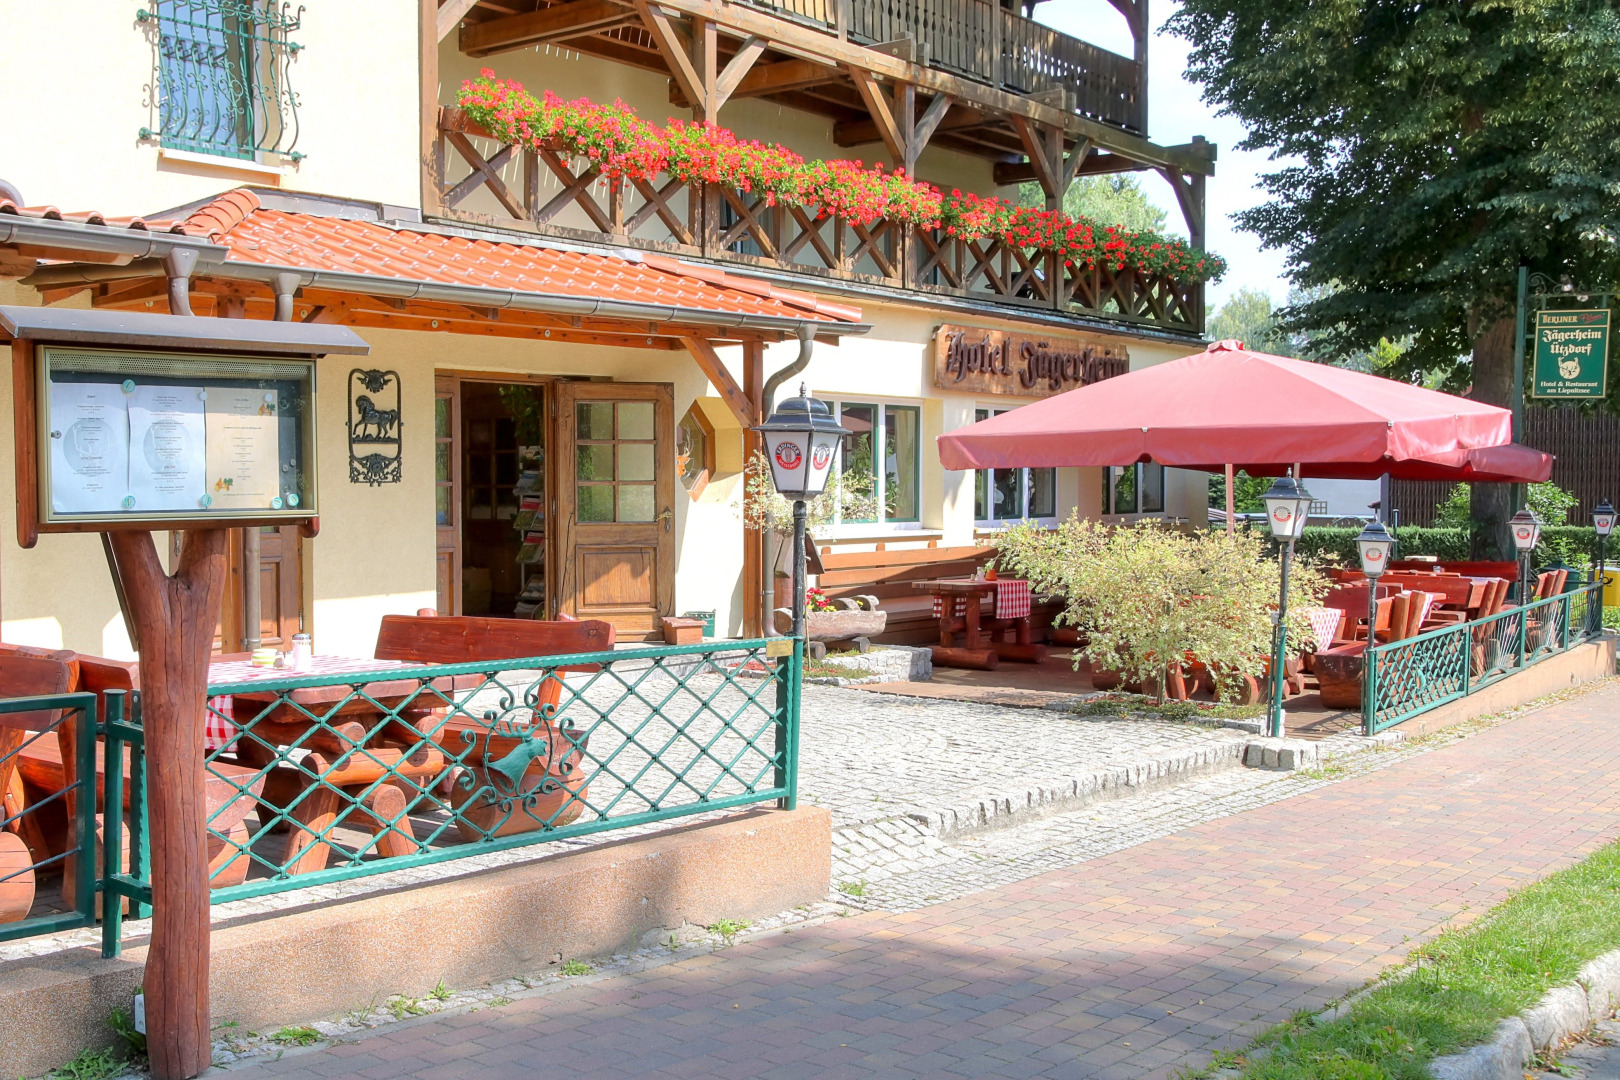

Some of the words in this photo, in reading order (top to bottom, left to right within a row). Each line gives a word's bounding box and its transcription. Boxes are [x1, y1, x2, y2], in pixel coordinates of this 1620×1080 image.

[1542, 314, 1578, 324] BERLINER
[1542, 328, 1602, 343] Jägerheim
[1550, 341, 1592, 356] Ützdorf
[945, 331, 1013, 383] Hotel
[1018, 341, 1130, 391] Jägerheim
[1557, 387, 1591, 395] Liepnitzsee
[776, 442, 800, 455] ERDINGER
